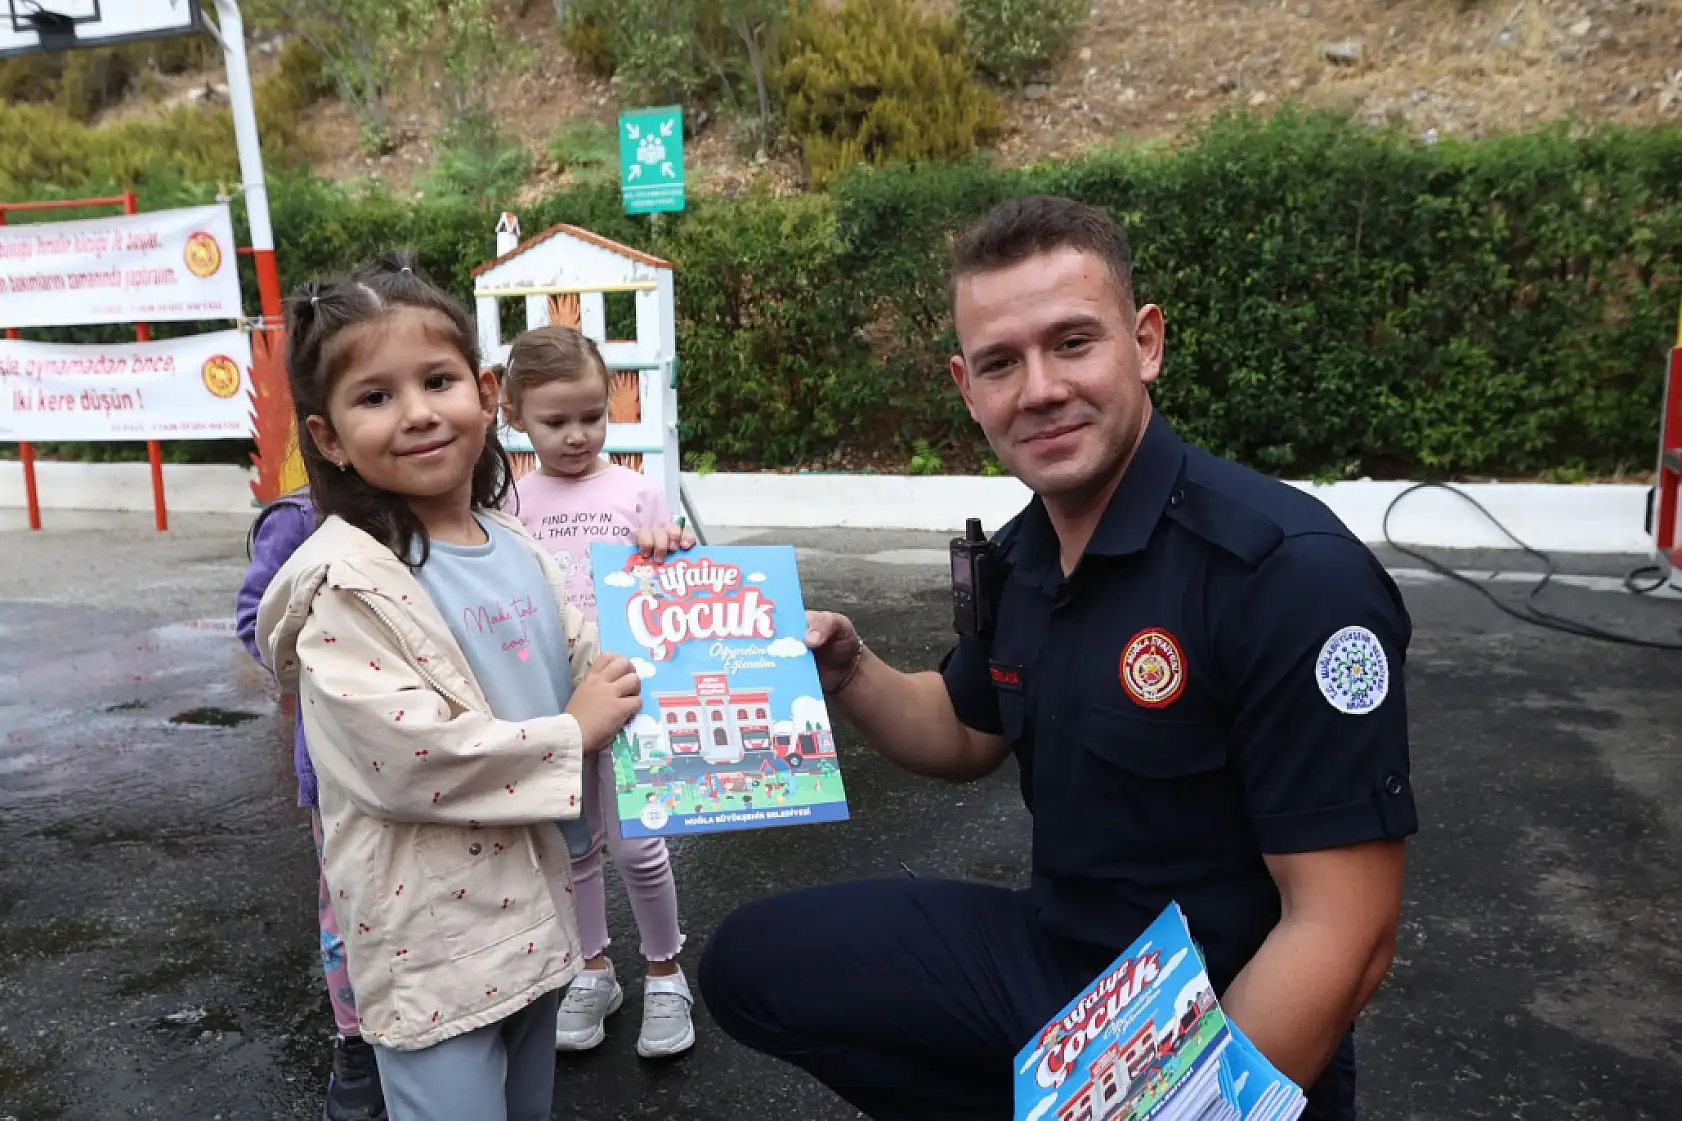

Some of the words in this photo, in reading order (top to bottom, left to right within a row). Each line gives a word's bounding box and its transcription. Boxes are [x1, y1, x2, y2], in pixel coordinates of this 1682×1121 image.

[37, 388, 76, 411] kere
[79, 387, 134, 418] düşün
[541, 514, 568, 526] FIND
[571, 512, 597, 524] JOY
[600, 512, 613, 524] IN
[548, 526, 578, 538] THAT
[581, 525, 609, 536] YOU
[612, 525, 631, 537] DO
[628, 592, 774, 661] Çocuk
